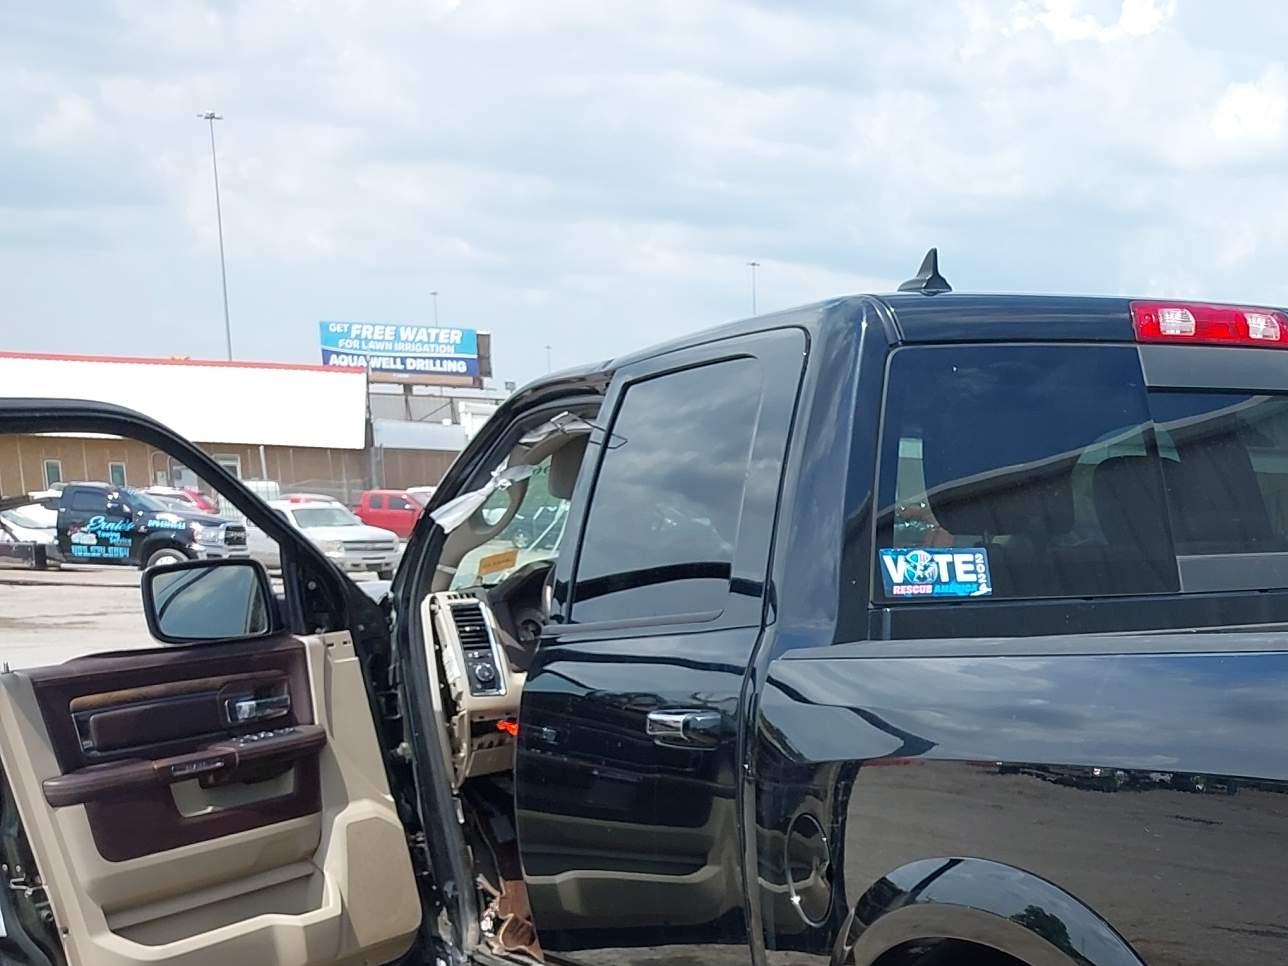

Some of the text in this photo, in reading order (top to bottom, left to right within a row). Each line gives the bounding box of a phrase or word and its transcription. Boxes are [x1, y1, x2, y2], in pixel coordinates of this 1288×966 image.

[329, 323, 463, 344] GET FREE WATER
[338, 339, 455, 354] FOR LAWN IRRIGATION
[329, 354, 468, 373] AQUA WELL DRILLING
[893, 584, 933, 595] RESCUE
